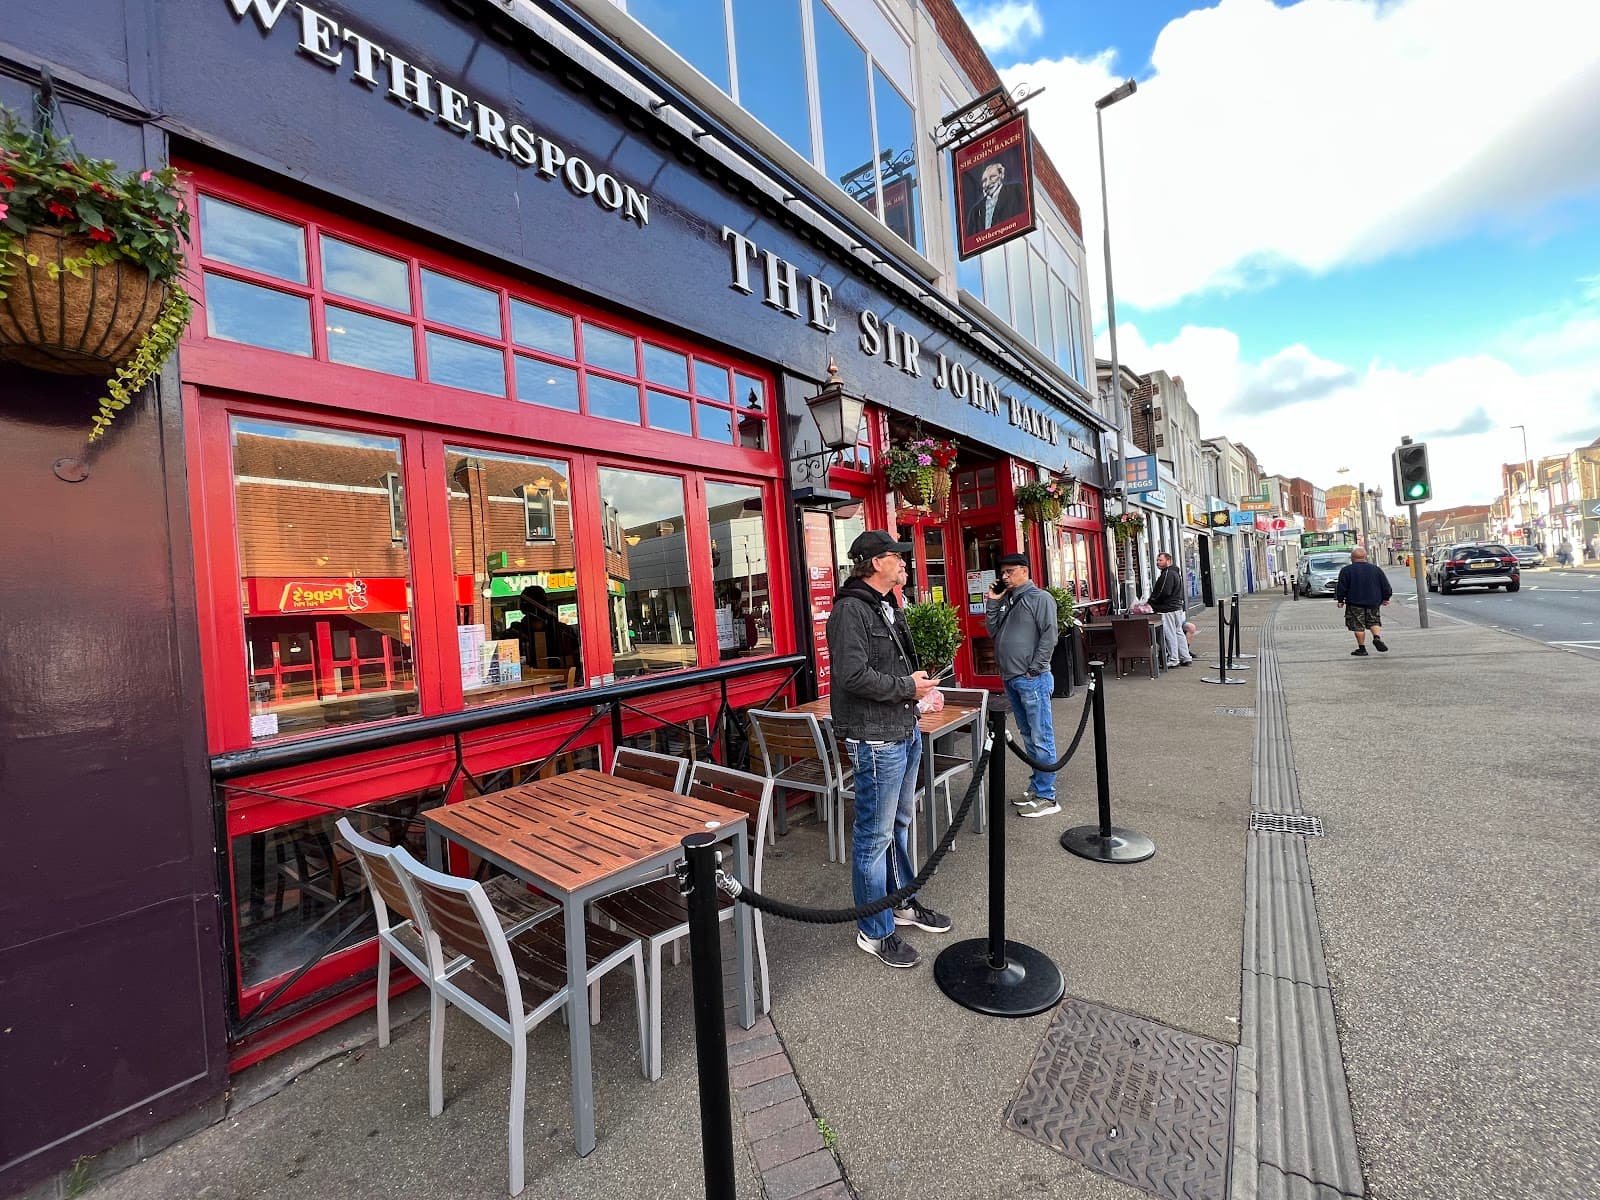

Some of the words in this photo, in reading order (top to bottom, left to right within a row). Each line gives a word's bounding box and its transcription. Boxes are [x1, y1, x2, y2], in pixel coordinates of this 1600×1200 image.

[960, 157, 973, 170] SIR
[973, 149, 994, 165] JOHN
[994, 133, 1021, 152] BAKER
[981, 137, 996, 149] THE
[975, 222, 1017, 244] Wetherspoon
[722, 225, 836, 333] THE
[860, 309, 922, 378] SIR
[934, 352, 1000, 417] JOHN
[1008, 394, 1059, 446] BAKER
[1126, 480, 1153, 489] REGGS
[1121, 1073, 1143, 1116] TROJAN
